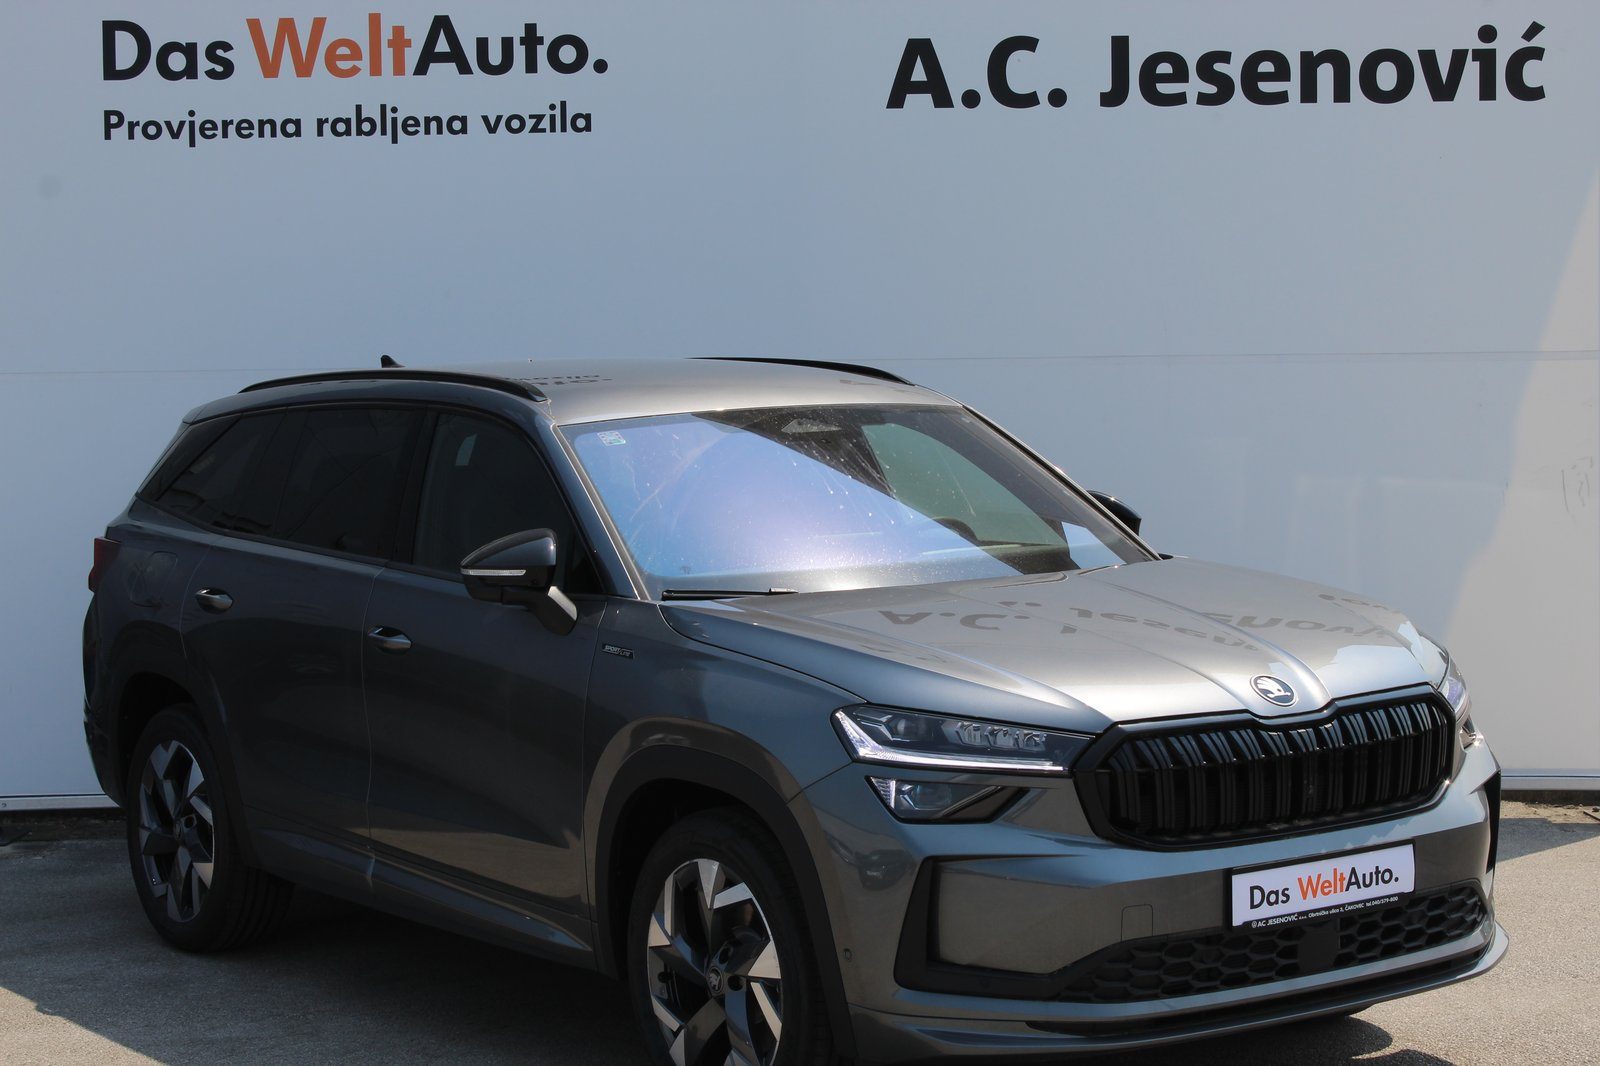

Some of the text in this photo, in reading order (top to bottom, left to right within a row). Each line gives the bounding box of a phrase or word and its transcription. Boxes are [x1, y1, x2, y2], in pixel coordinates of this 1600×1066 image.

[102, 13, 608, 81] Das WeltAuto.
[886, 22, 1546, 109] A.C. Jesenović
[104, 101, 592, 148] Provjerena rabljena vozila
[1250, 865, 1399, 910] Das WeltAuto.
[1267, 913, 1298, 926] JESENOVIĆ
[1344, 902, 1365, 911] ČAKOVEC
